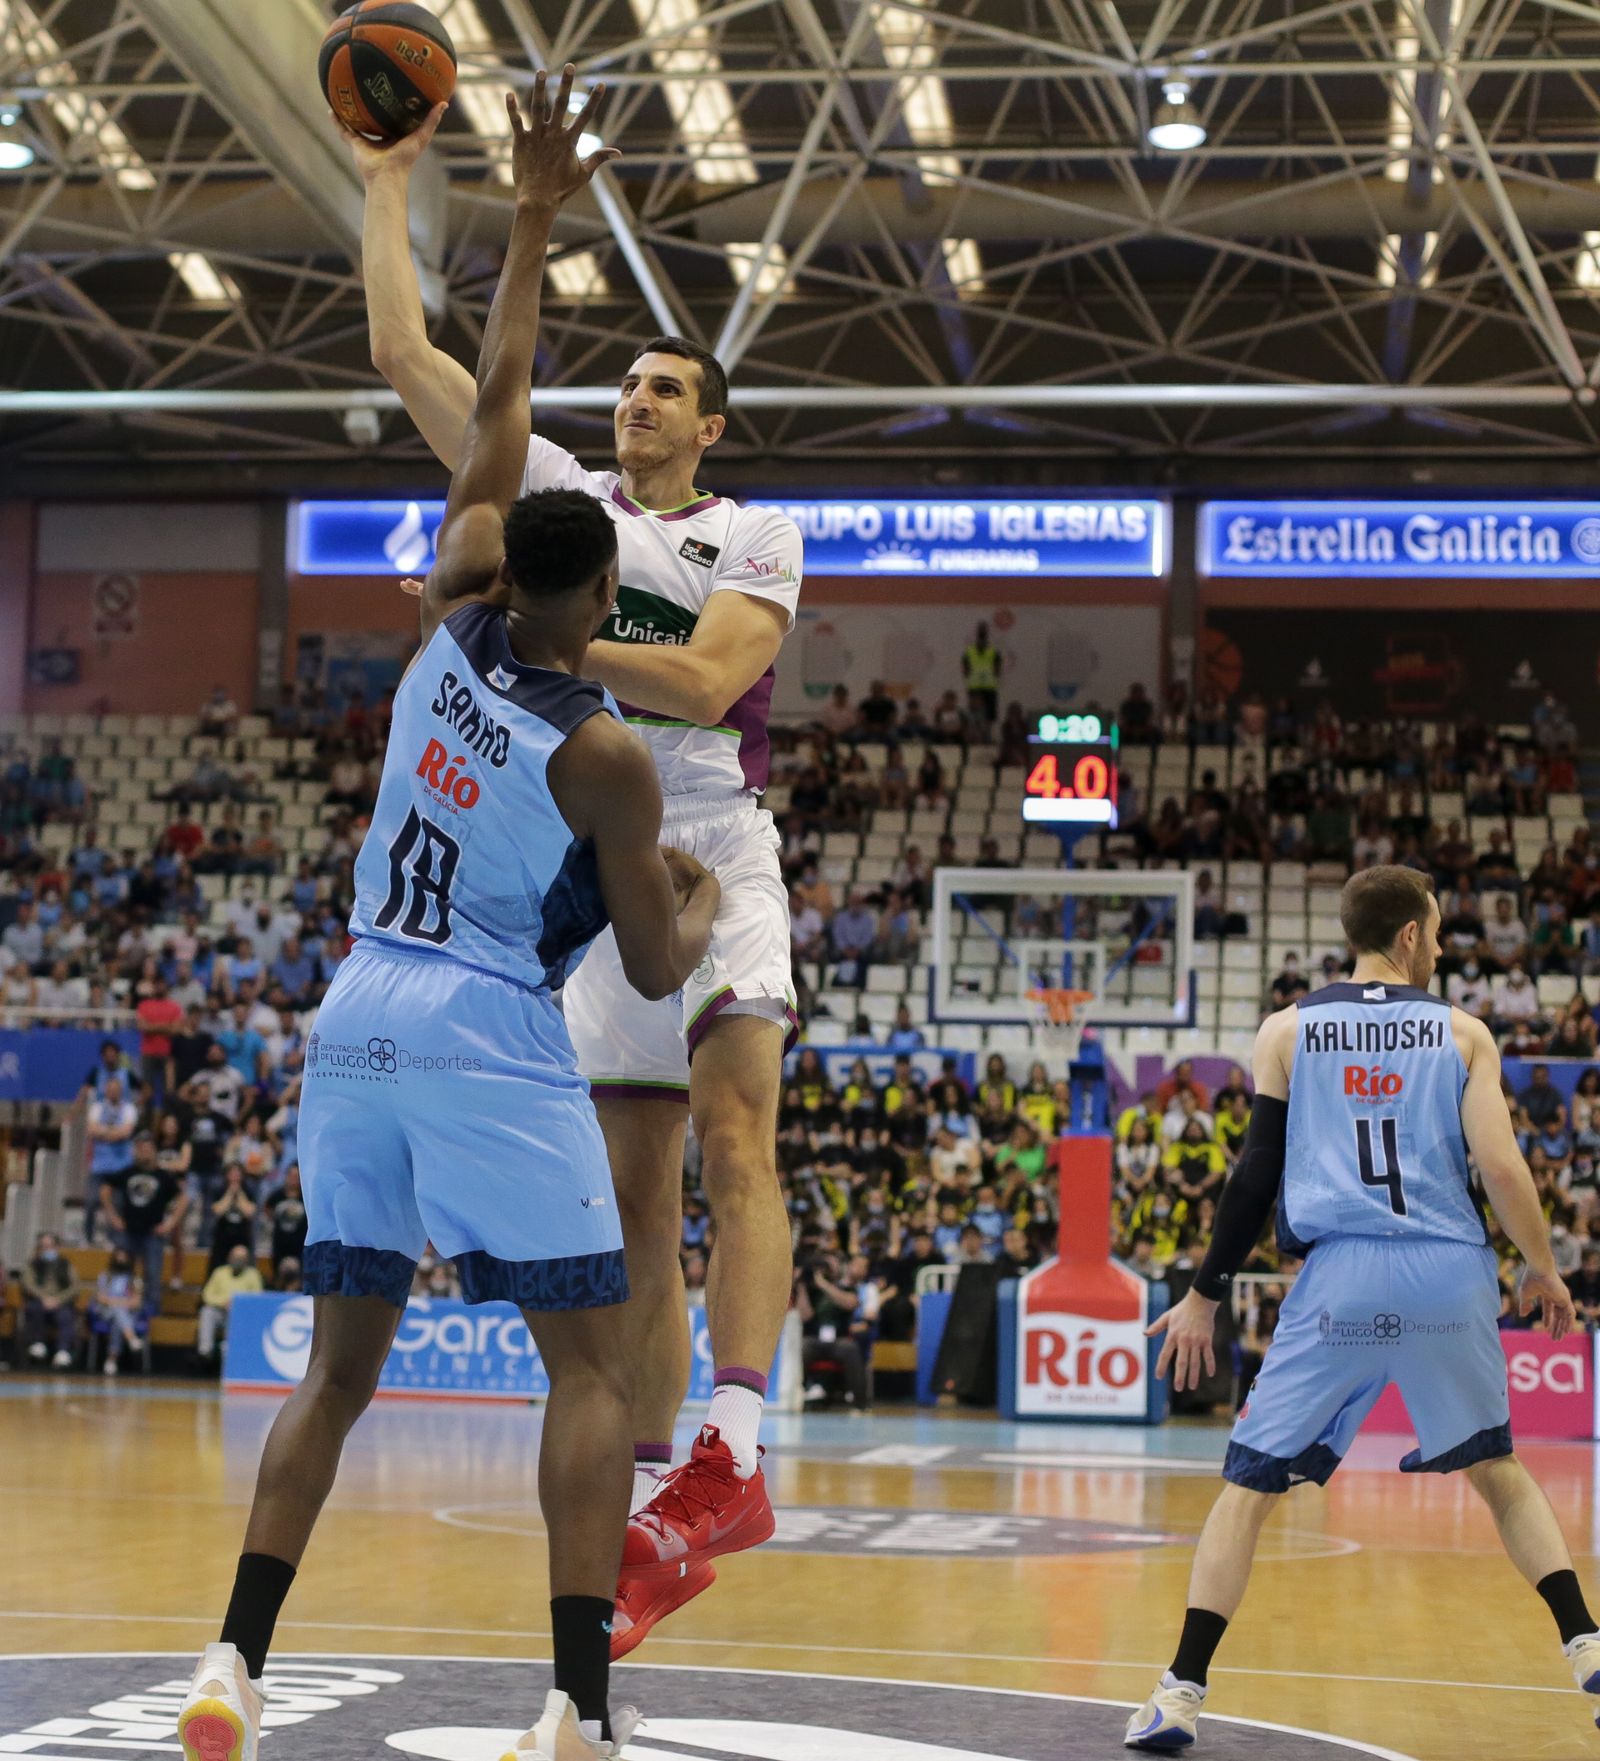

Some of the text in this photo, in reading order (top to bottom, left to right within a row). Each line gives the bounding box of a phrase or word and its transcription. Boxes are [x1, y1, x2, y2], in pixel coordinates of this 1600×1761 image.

[895, 505, 976, 541] LUIS
[989, 504, 1147, 542] IGLESIAS
[1223, 513, 1562, 563] Estrella Galicia
[431, 671, 512, 769] SAKHO
[416, 736, 481, 810] Río
[1025, 753, 1109, 800] 4.0
[373, 803, 461, 945] 18
[1304, 1018, 1444, 1053] KALINOSKI
[330, 1054, 367, 1069] LUGO
[399, 1050, 483, 1073] Deportes
[1343, 1065, 1404, 1097] Río
[1354, 1117, 1409, 1218] 4
[1341, 1328, 1373, 1338] LUGO
[1403, 1319, 1471, 1335] Deportes
[1024, 1328, 1141, 1389] Río
